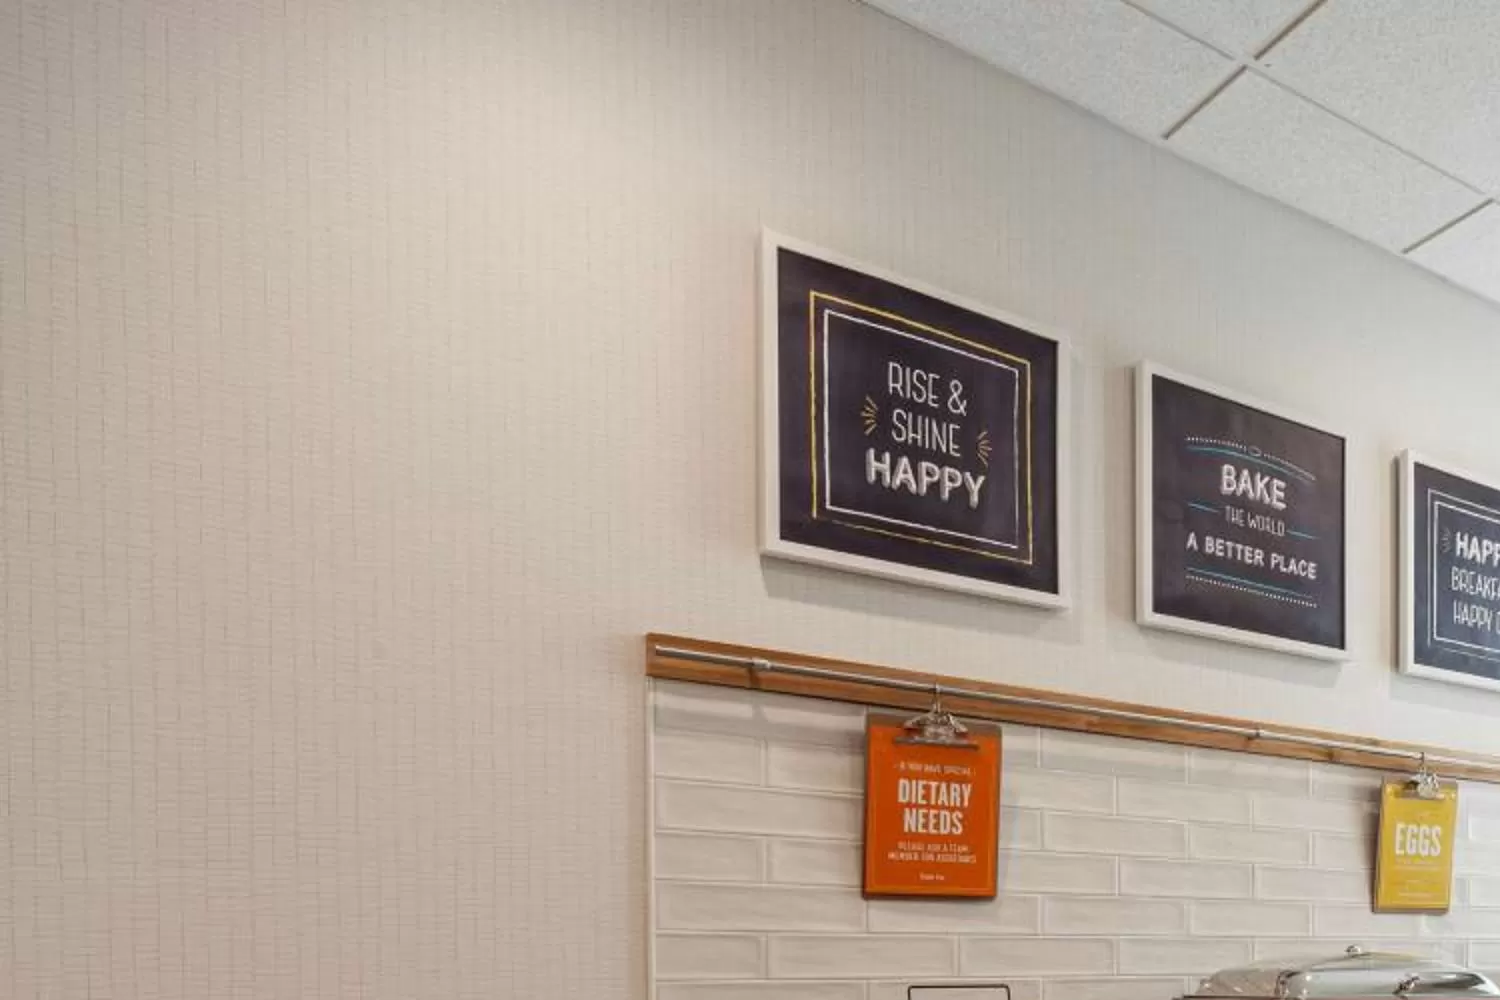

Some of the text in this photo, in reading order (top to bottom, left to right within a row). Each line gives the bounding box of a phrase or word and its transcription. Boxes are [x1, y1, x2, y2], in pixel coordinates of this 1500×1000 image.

[888, 361, 968, 417] RISE &
[891, 409, 961, 457] SHINE
[865, 447, 986, 509] HAPPY
[1220, 463, 1288, 510] BAKE
[1225, 505, 1285, 537] THE WORLD
[1186, 531, 1318, 580] A BETTER PLACE
[1453, 599, 1492, 634] HAPPY
[897, 778, 973, 808] DIETARY
[903, 807, 964, 836] NEEDS
[1394, 821, 1442, 858] EGGS
